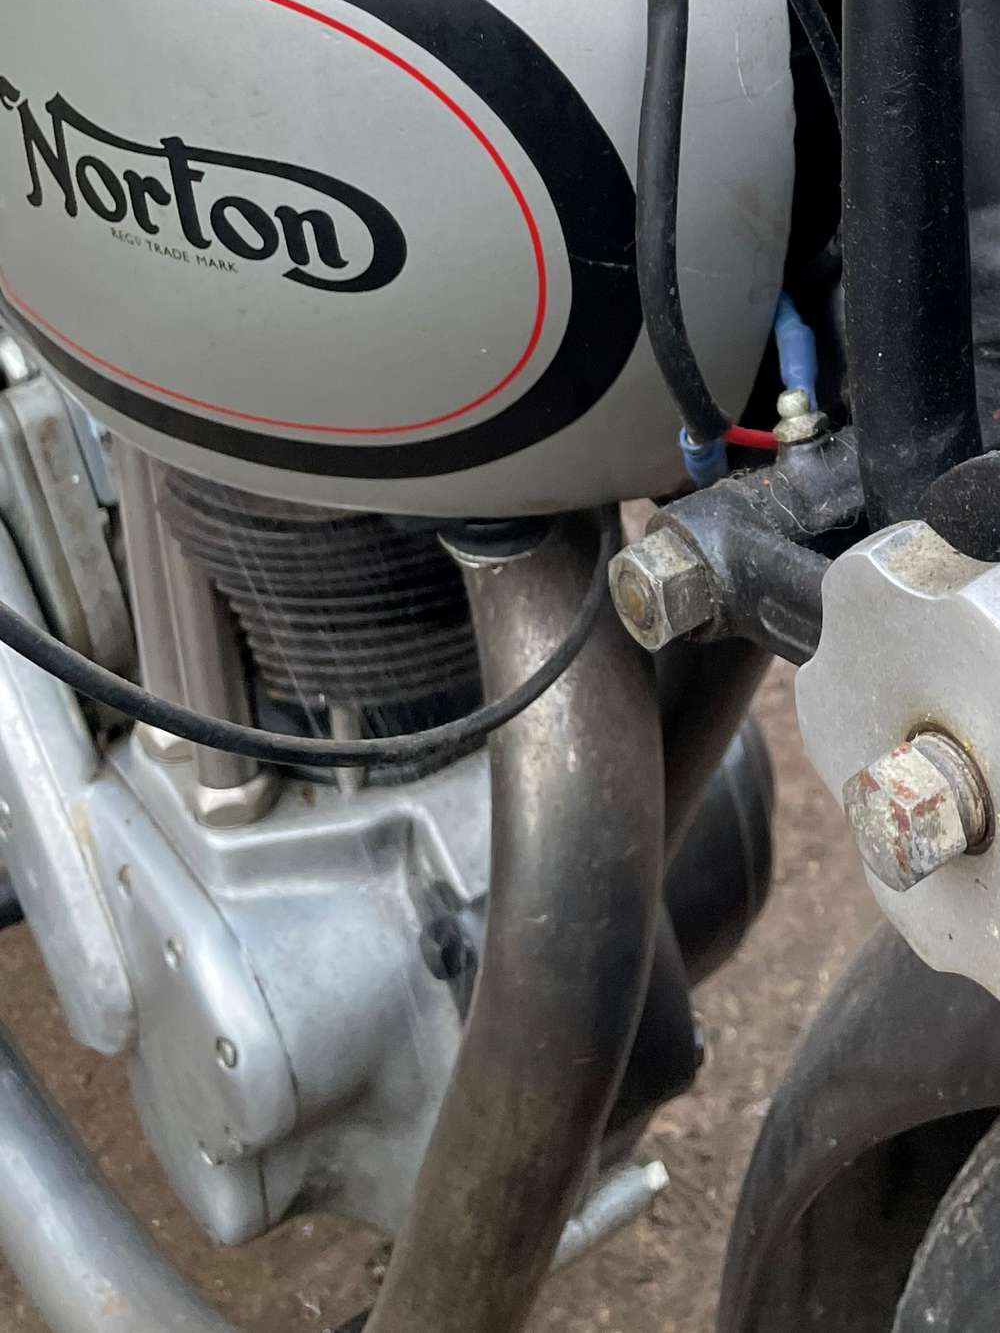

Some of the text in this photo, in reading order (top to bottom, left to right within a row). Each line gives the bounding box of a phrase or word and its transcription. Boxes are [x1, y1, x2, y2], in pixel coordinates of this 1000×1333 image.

[0, 76, 407, 293] Norton
[145, 240, 190, 263] TRADE
[195, 254, 238, 273] MARK
